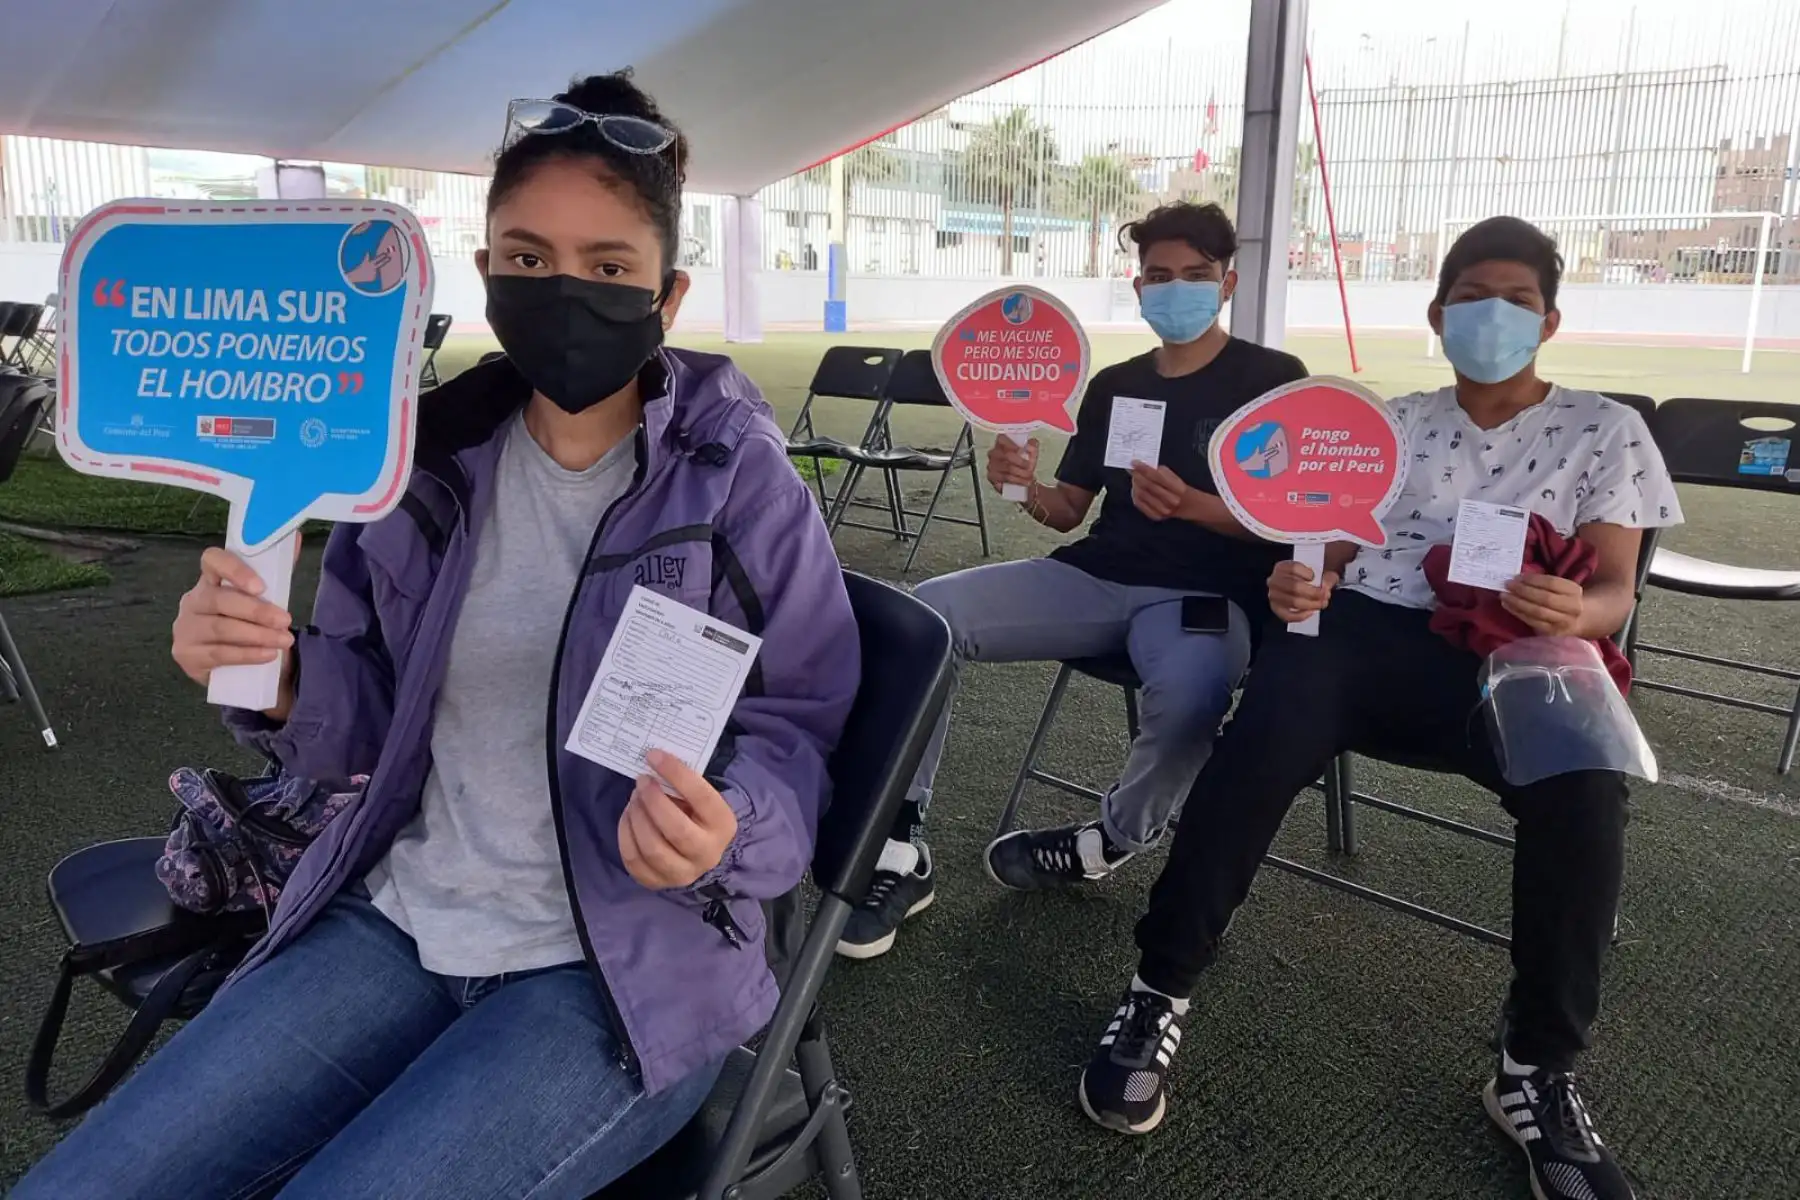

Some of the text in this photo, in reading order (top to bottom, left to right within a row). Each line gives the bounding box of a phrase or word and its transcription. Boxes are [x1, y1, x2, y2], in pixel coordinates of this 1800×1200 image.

[183, 287, 269, 322] LIMA
[276, 290, 347, 324] SUR
[1000, 330, 1053, 344] VACUNE
[111, 329, 367, 363] TODOS PONEMOS
[964, 345, 1061, 360] PERO ME SIGO
[137, 367, 172, 399] EL
[1301, 427, 1350, 444] Pongo
[1300, 442, 1380, 457] el hombro
[1297, 458, 1385, 475] por el Perú
[634, 554, 687, 588] alley
